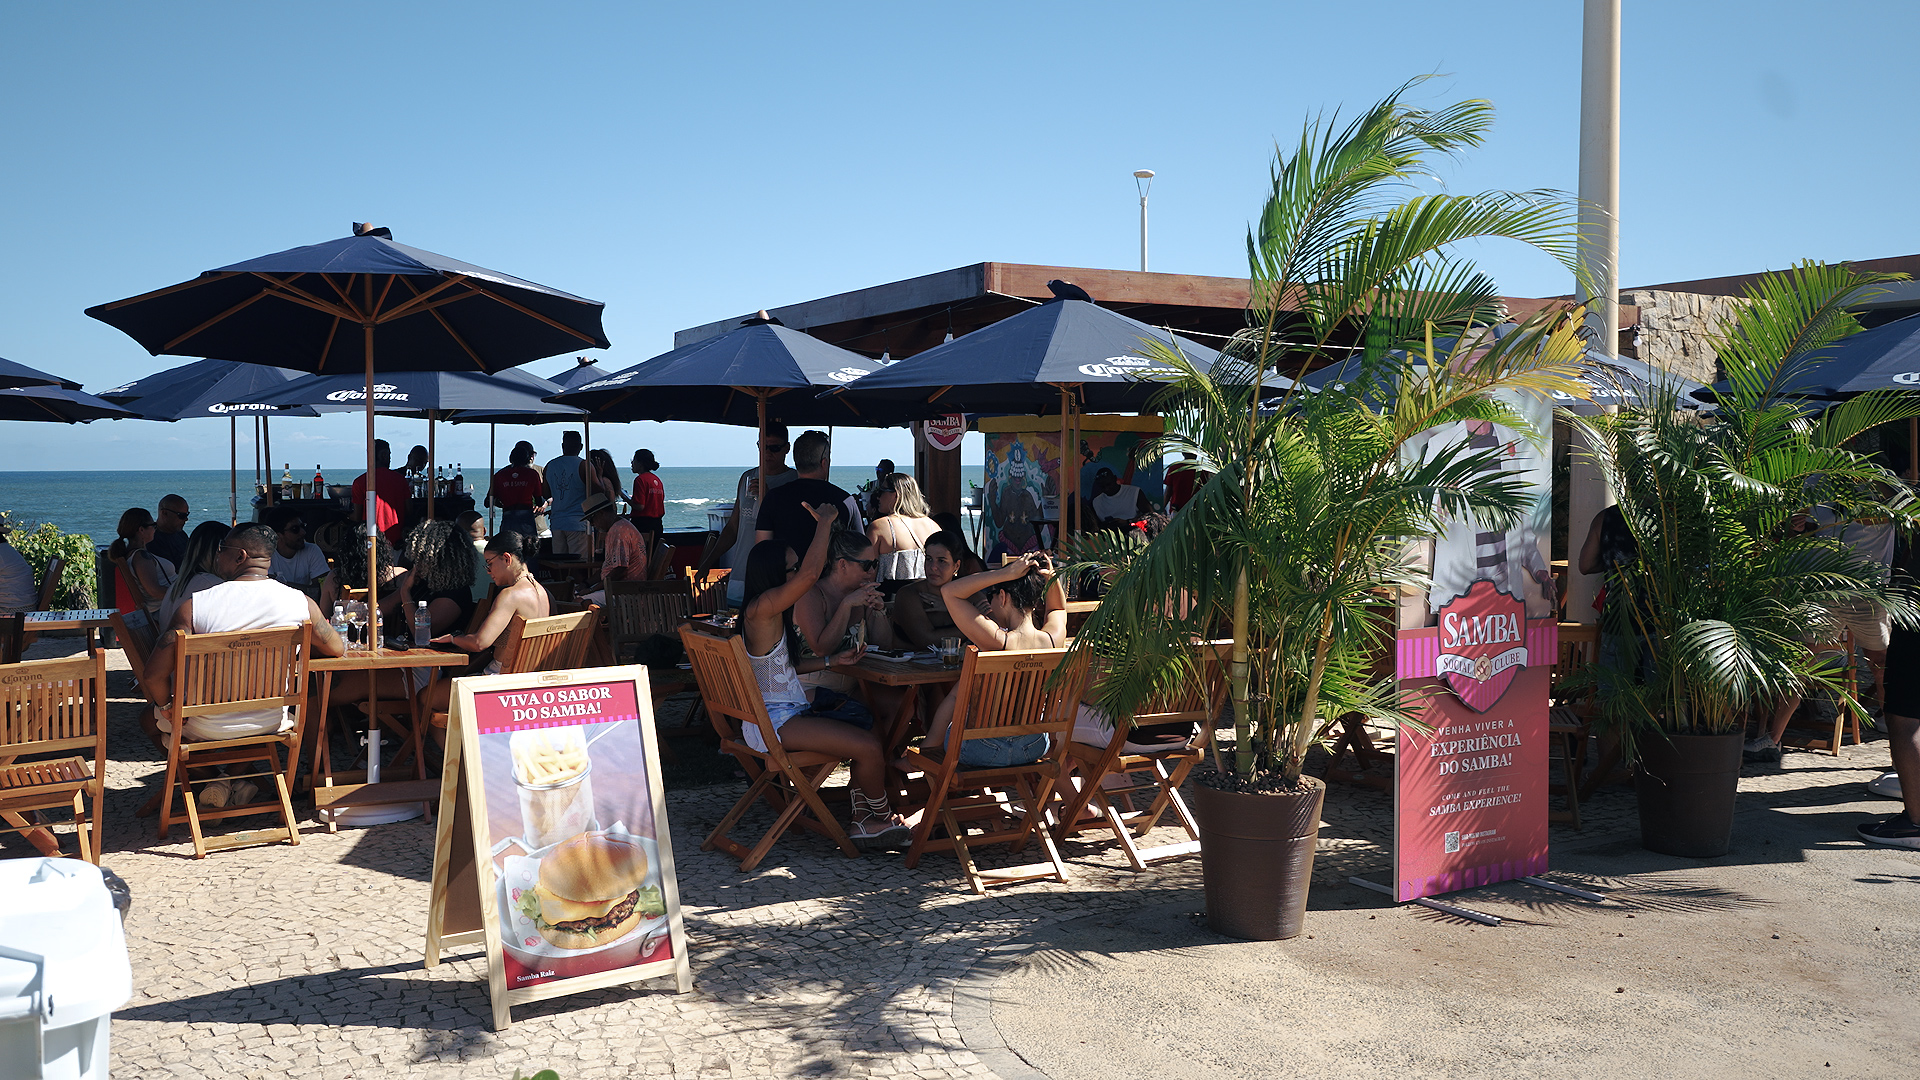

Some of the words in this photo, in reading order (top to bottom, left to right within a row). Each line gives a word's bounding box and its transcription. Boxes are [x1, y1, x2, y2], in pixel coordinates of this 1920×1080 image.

[1443, 612, 1522, 648] SAMBA
[228, 640, 262, 650] Corona
[1013, 660, 1045, 670] Corona
[1443, 657, 1472, 675] SOCIAL
[1494, 651, 1521, 671] CLUBE
[1, 672, 44, 686] Corona
[498, 692, 540, 708] VIVA
[542, 691, 555, 704] O
[558, 687, 612, 703] SABOR
[513, 707, 538, 722] DO
[540, 702, 602, 719] SAMBA!
[1438, 724, 1471, 737] VENHA
[1475, 720, 1504, 732] VIVER
[1508, 719, 1514, 728] A
[1430, 733, 1522, 758] EXPERIÊNCIA
[1439, 759, 1460, 776] DO
[1461, 753, 1512, 773] SAMBA!
[1441, 793, 1461, 801] COME
[1462, 790, 1477, 798] AND
[1478, 787, 1495, 796] FEEL
[1497, 784, 1511, 792] THE
[1429, 802, 1461, 817] SAMBA
[1463, 793, 1522, 811] EXPERIENCE!
[516, 972, 540, 982] Samba
